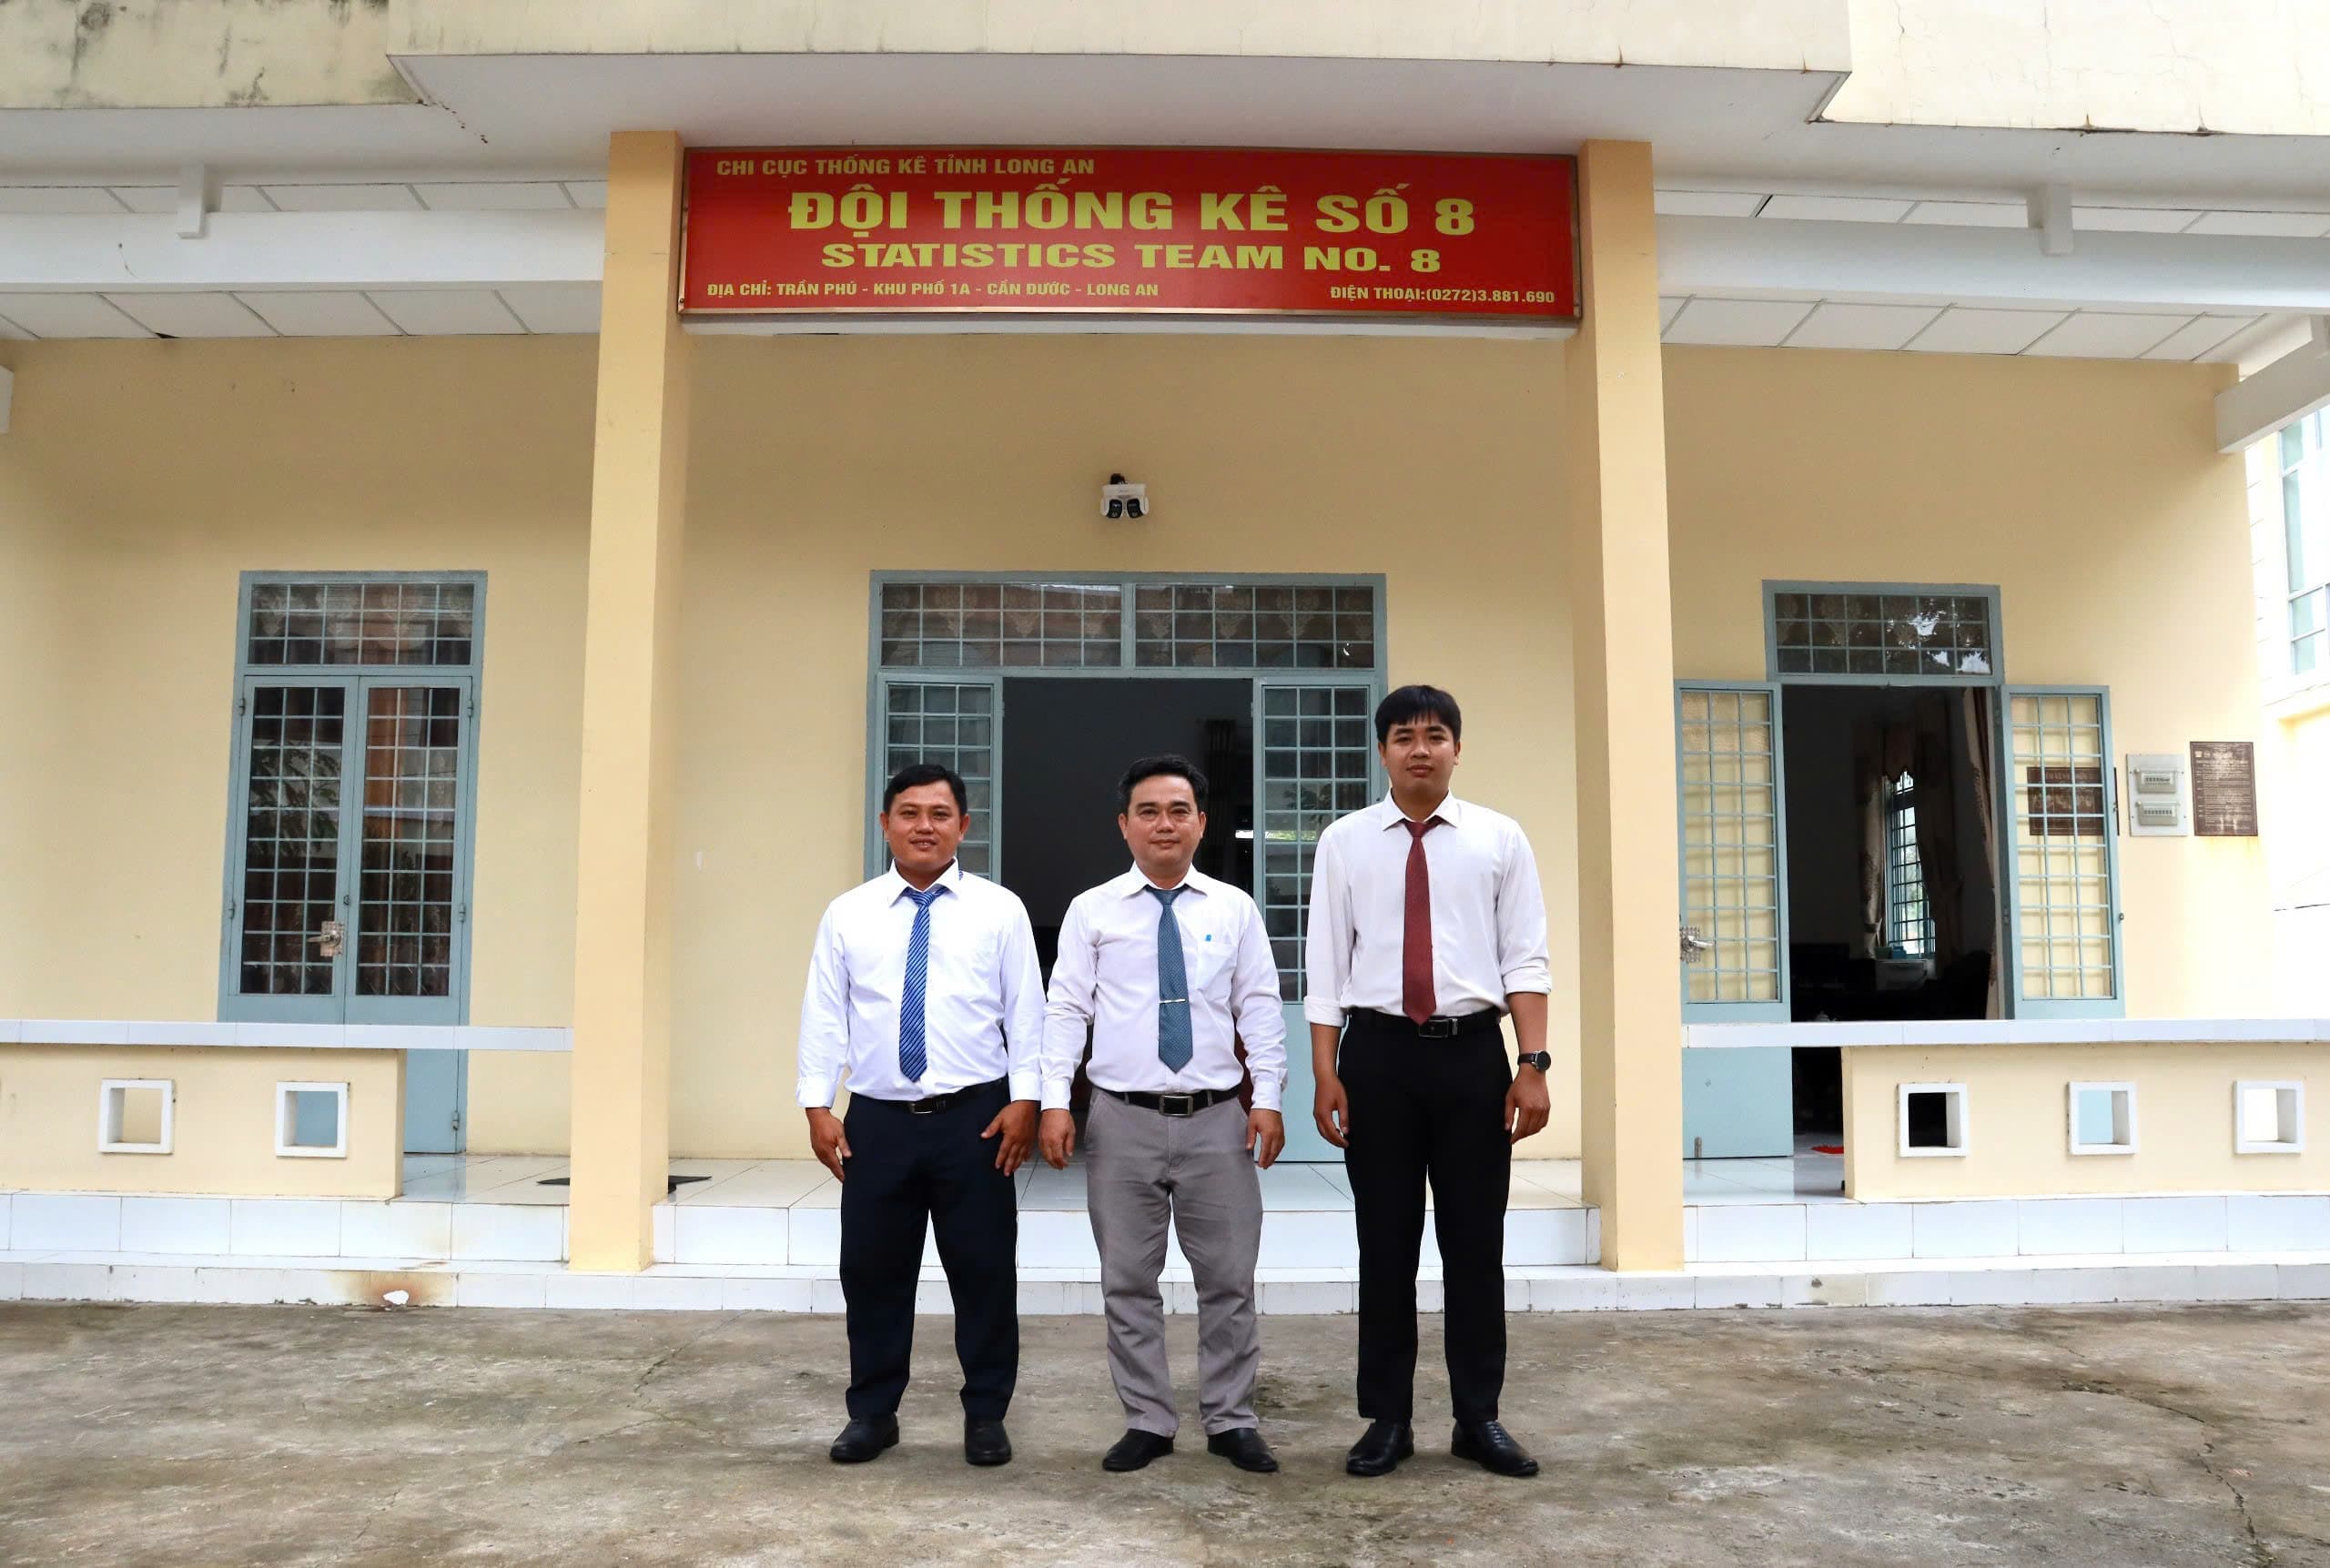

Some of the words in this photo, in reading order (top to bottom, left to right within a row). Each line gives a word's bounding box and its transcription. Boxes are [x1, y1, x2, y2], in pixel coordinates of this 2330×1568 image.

[716, 159, 755, 176] CHI
[763, 159, 808, 178] CỤC
[816, 153, 890, 176] THỐNG
[898, 156, 927, 175] KÊ
[935, 154, 988, 175] TỈNH
[995, 158, 1055, 175] LONG
[1061, 158, 1095, 175] AN
[787, 183, 908, 238] ĐỘI
[934, 177, 1174, 232] THỐNG
[1200, 184, 1290, 232] KÊ
[1315, 183, 1410, 234] SỐ
[1434, 197, 1475, 236] 8
[821, 241, 1117, 270] STATISTICS
[1134, 243, 1284, 271] TEAM
[1303, 246, 1392, 273] NO.
[1410, 248, 1442, 273] 8
[706, 282, 734, 298] ĐỊA
[824, 280, 858, 296] PHÚ
[873, 282, 907, 296] KHU
[911, 278, 946, 296] PHỐ
[950, 282, 971, 296] 1A
[1026, 280, 1071, 297] ĐƯỚC
[1086, 283, 1131, 297] LONG
[1135, 283, 1160, 297] AN
[1330, 284, 1369, 301] ĐIỆN
